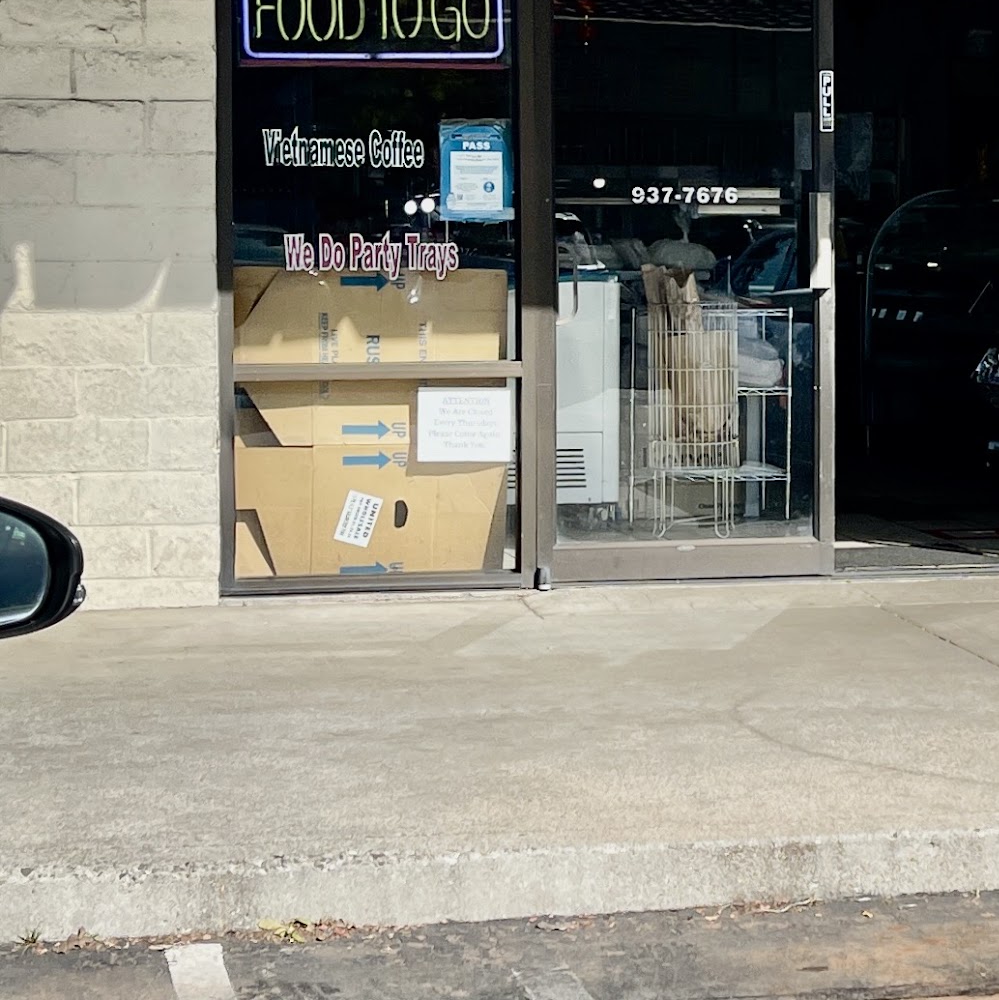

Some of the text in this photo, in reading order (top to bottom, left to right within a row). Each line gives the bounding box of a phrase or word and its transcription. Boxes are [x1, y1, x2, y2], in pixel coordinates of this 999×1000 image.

[822, 76, 831, 117] PULL
[262, 126, 425, 168] Vietnamese Coffee
[462, 141, 491, 150] PASS
[631, 186, 739, 204] 937-7676
[284, 230, 460, 280] We Do Party Trays
[366, 334, 380, 364] RUS
[391, 422, 406, 438] UP
[392, 452, 407, 468] UP
[362, 503, 379, 538] UNITED
